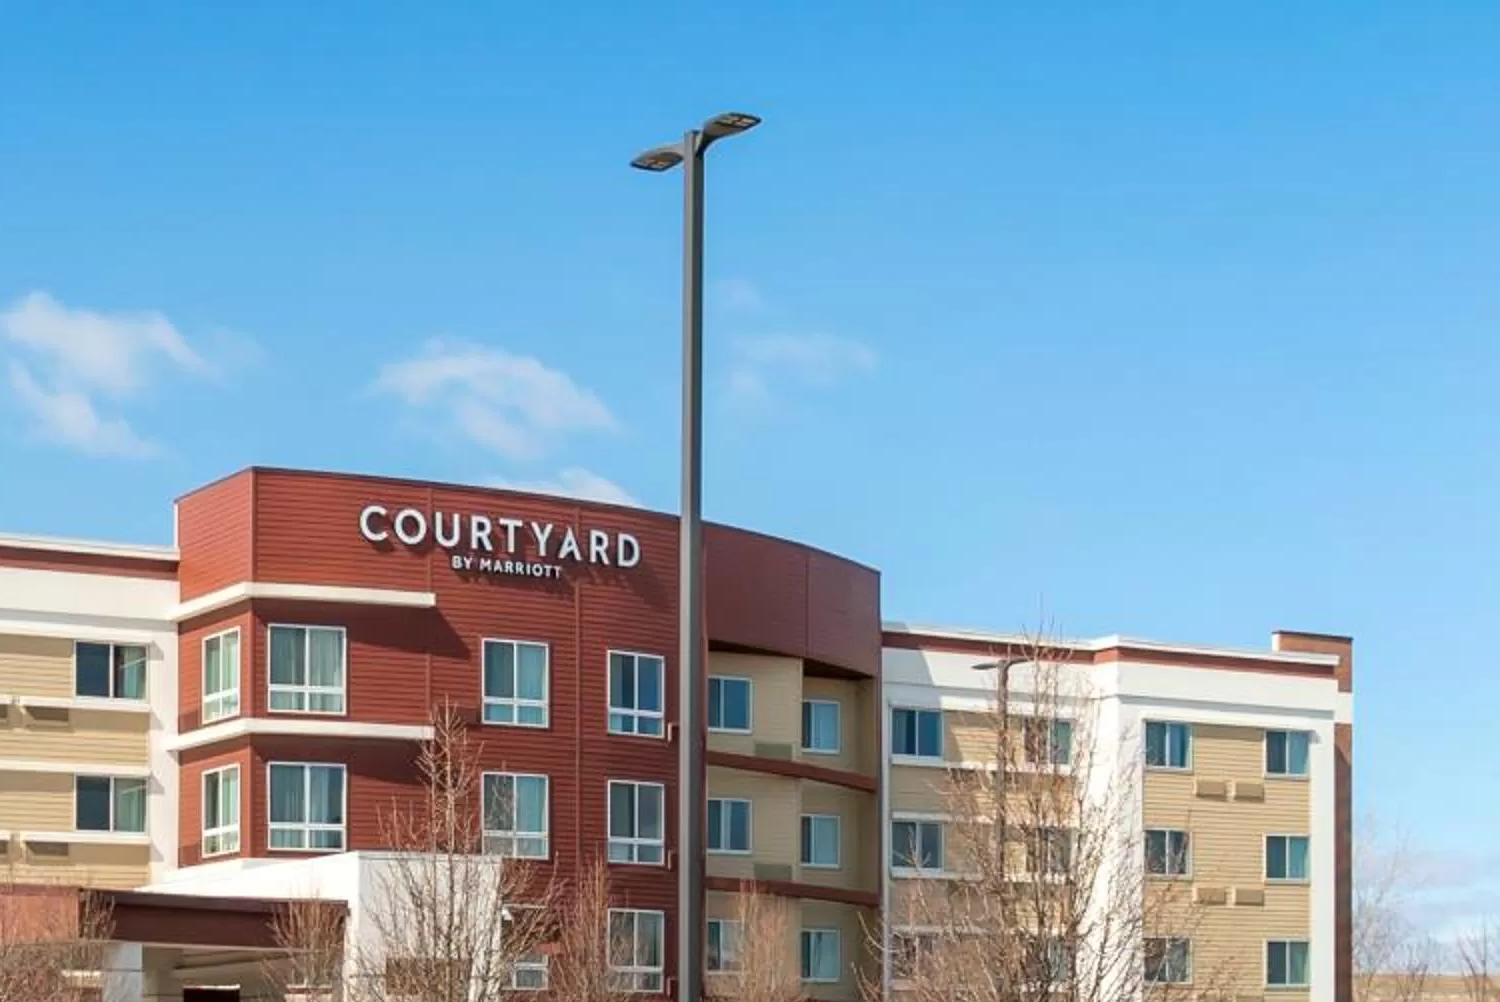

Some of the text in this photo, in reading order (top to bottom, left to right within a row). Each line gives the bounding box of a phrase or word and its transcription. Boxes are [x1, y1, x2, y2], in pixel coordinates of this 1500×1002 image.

[359, 505, 640, 568] COURTYARD
[452, 555, 562, 579] BY MARRIOTT
